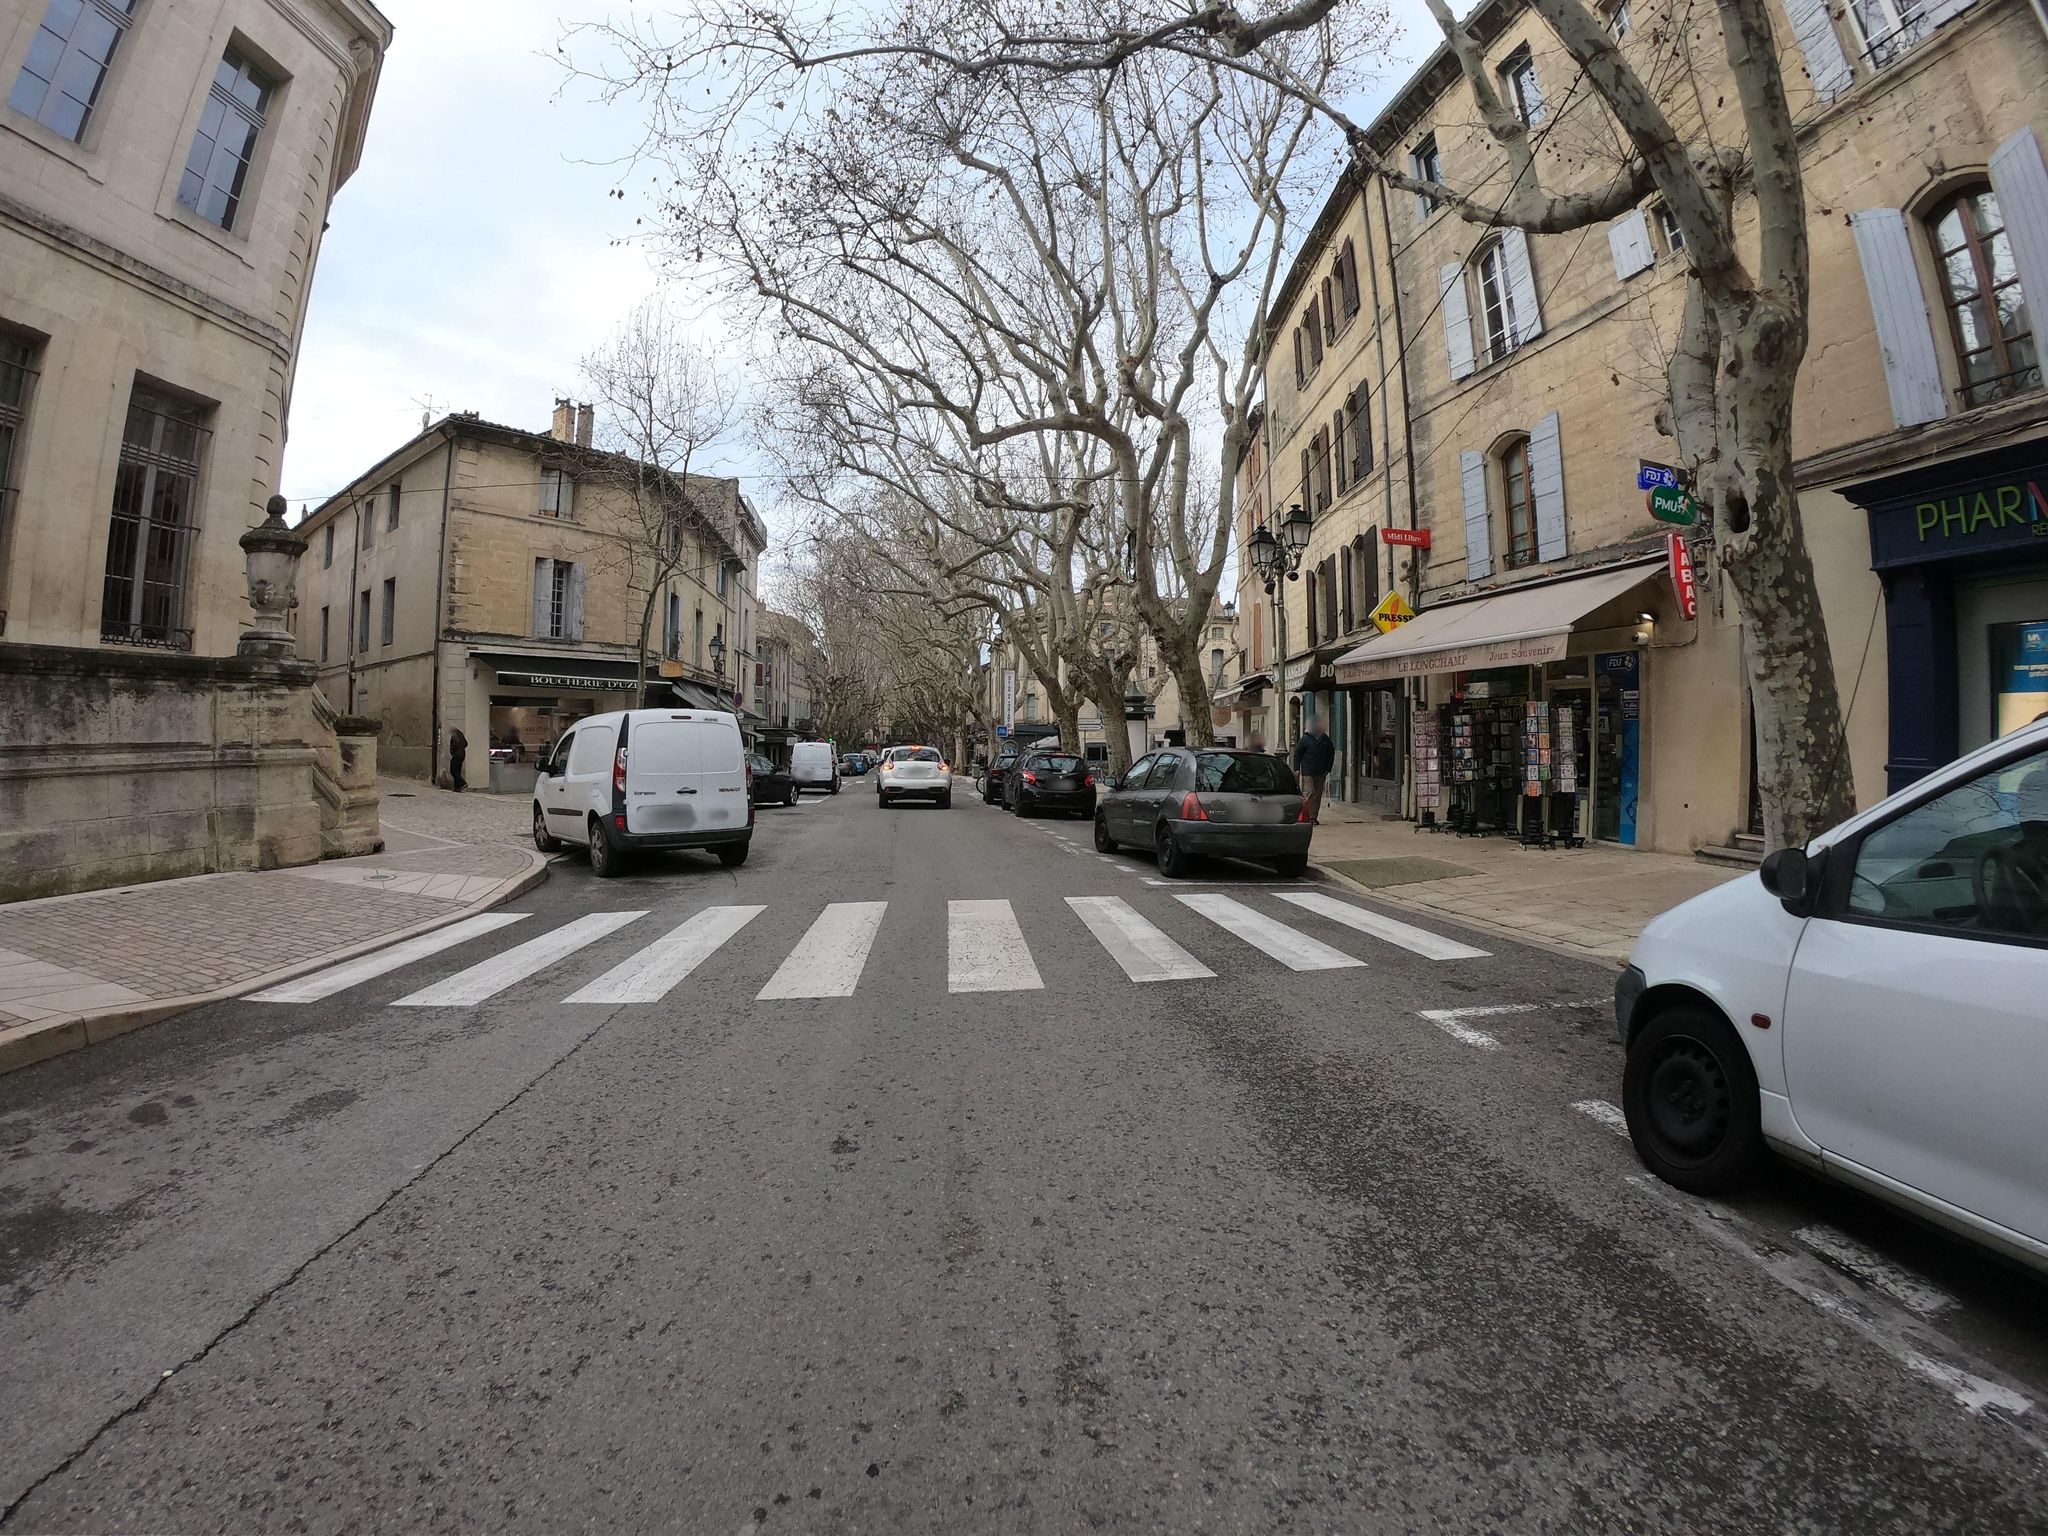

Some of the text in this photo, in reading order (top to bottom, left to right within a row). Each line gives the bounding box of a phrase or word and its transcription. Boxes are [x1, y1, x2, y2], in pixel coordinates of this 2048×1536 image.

[1645, 470, 1661, 482] FDJ
[1654, 496, 1678, 513] PMU
[1404, 534, 1422, 542] Libre
[1676, 536, 1697, 616] TABAC
[1489, 645, 1556, 661] Jeux Souvenirs
[1398, 655, 1468, 673] LE LONGCHAMP
[530, 676, 604, 688] BOUCHERIE
[608, 680, 648, 691] D'UZ
